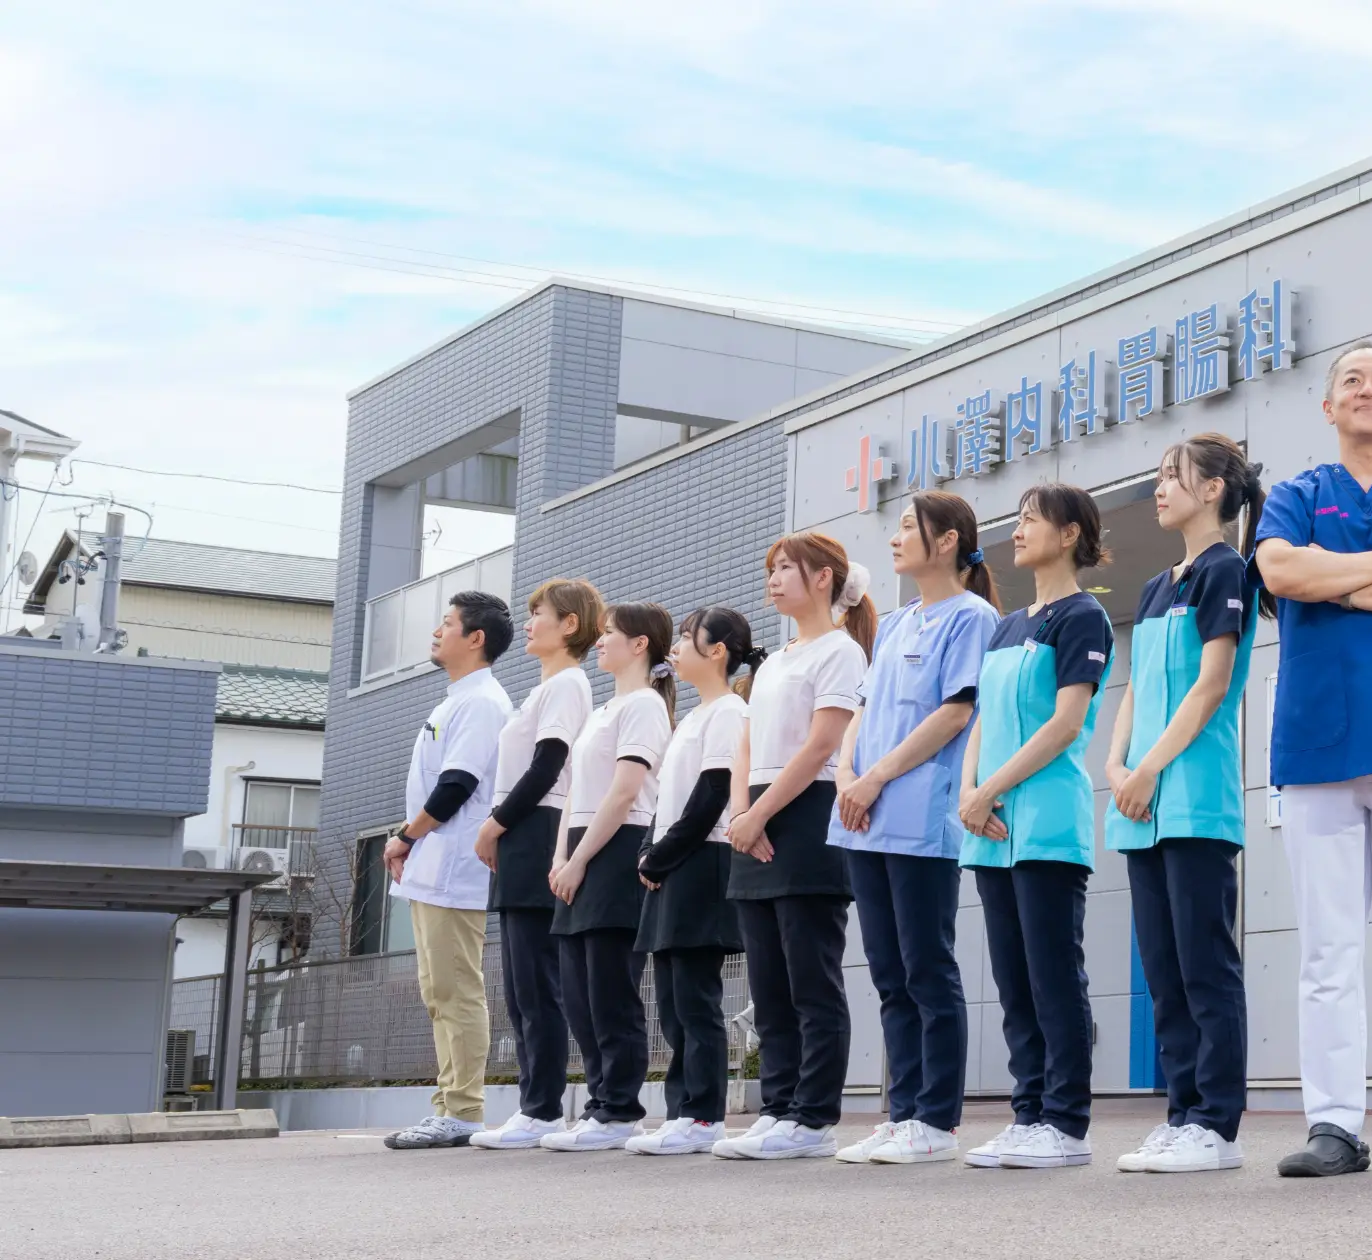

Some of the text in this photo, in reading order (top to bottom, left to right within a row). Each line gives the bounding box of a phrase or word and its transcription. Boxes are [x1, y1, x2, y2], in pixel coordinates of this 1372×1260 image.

[907, 278, 1286, 489] 小澤内科胃腸科
